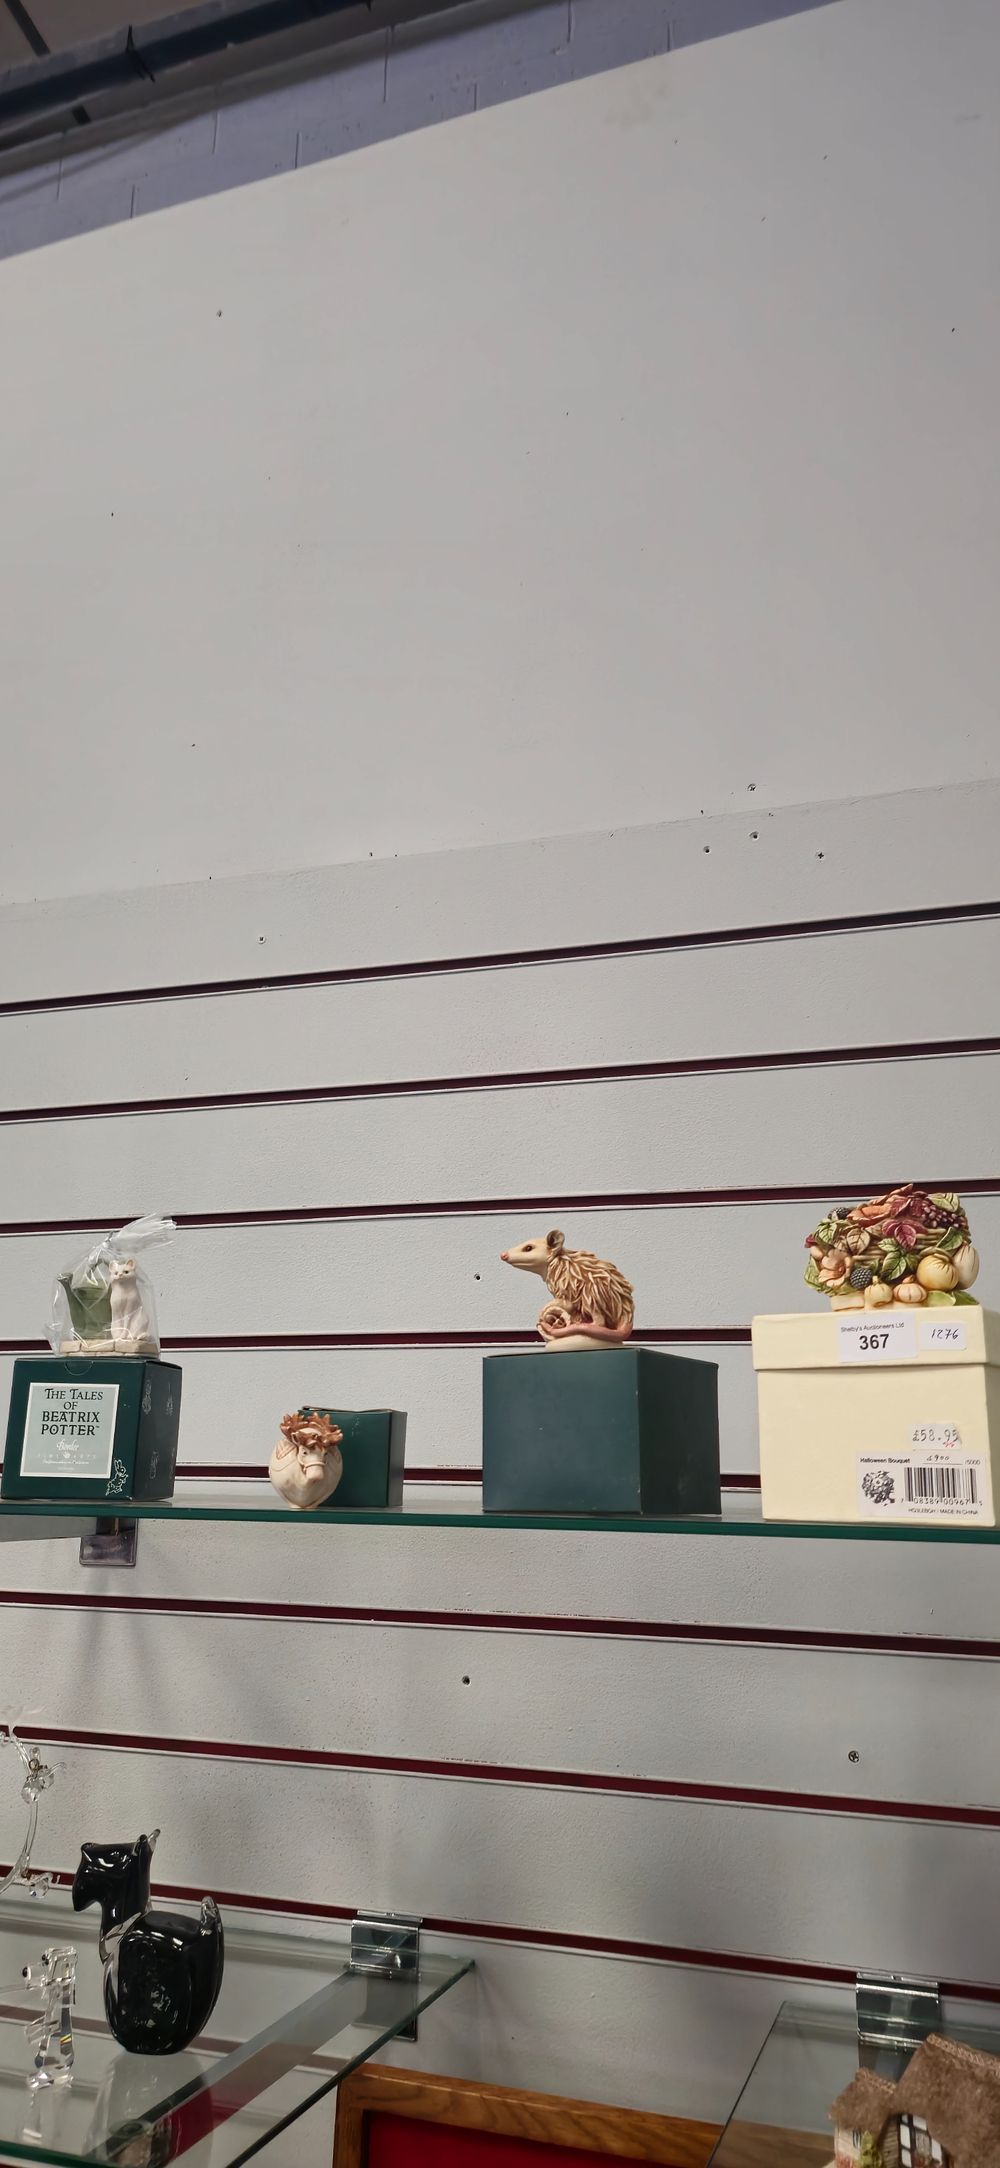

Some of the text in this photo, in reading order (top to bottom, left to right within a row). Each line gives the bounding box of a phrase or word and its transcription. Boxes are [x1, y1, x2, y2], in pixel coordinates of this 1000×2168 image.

[863, 1322, 895, 1331] Auctioneers
[895, 1321, 905, 1329] Ltd
[931, 1328, 959, 1340] 1276
[858, 1333, 890, 1350] 367
[45, 1388, 104, 1401] THE TALES
[63, 1401, 79, 1411] OF
[42, 1411, 100, 1423] BEATRIX
[912, 1429, 959, 1442] £58.95
[888, 1457, 911, 1465] Bouquet
